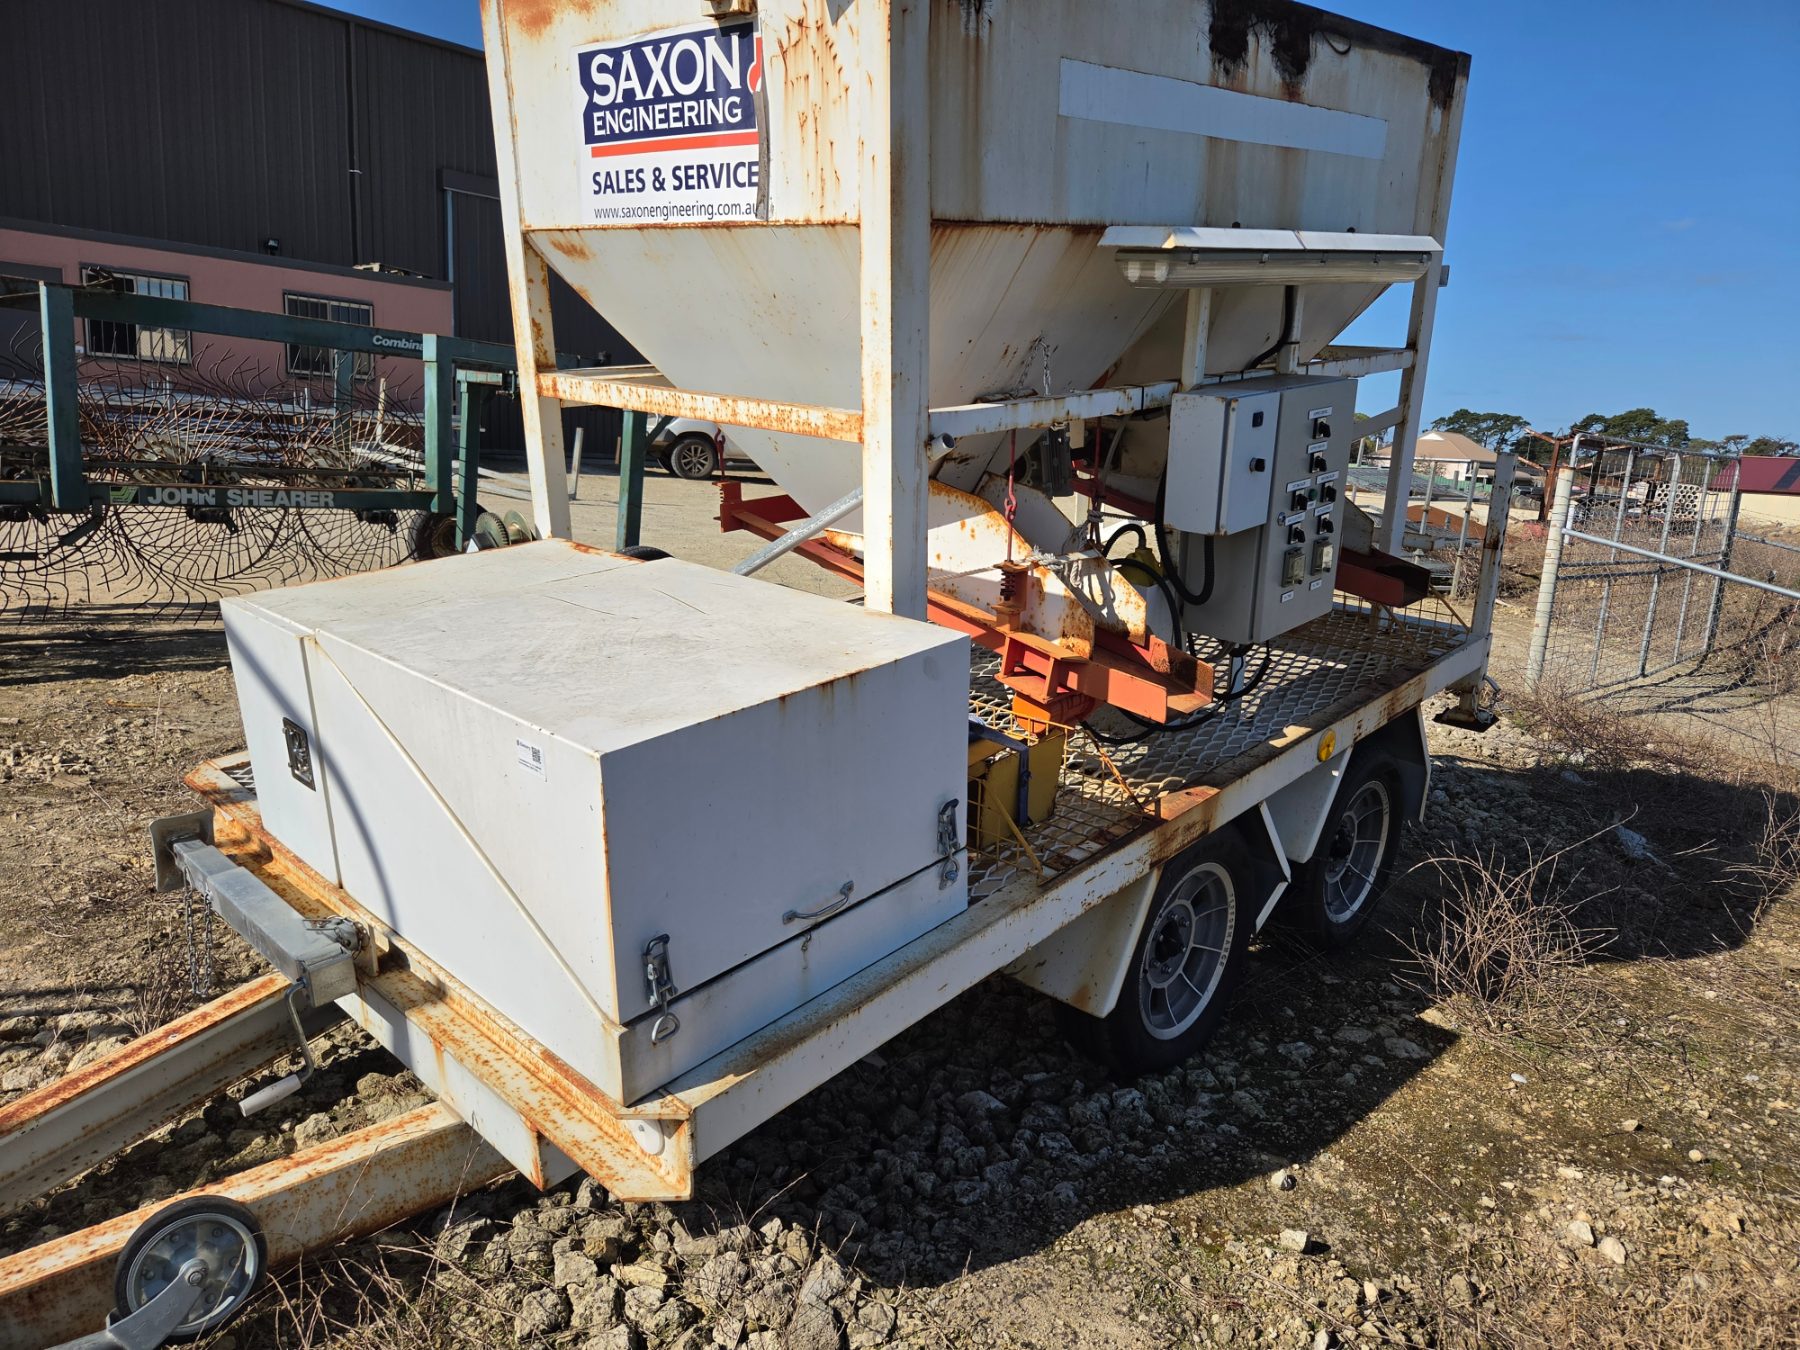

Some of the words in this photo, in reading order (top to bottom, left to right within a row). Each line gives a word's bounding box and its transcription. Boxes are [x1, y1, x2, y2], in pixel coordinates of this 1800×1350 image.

[590, 32, 742, 106] SAXON
[593, 96, 743, 136] ENGINEERING
[592, 168, 646, 195] SALES
[652, 166, 666, 192] &
[671, 161, 759, 190] SERVICE
[148, 487, 215, 506] JOHN
[227, 490, 334, 507] SHEARER
